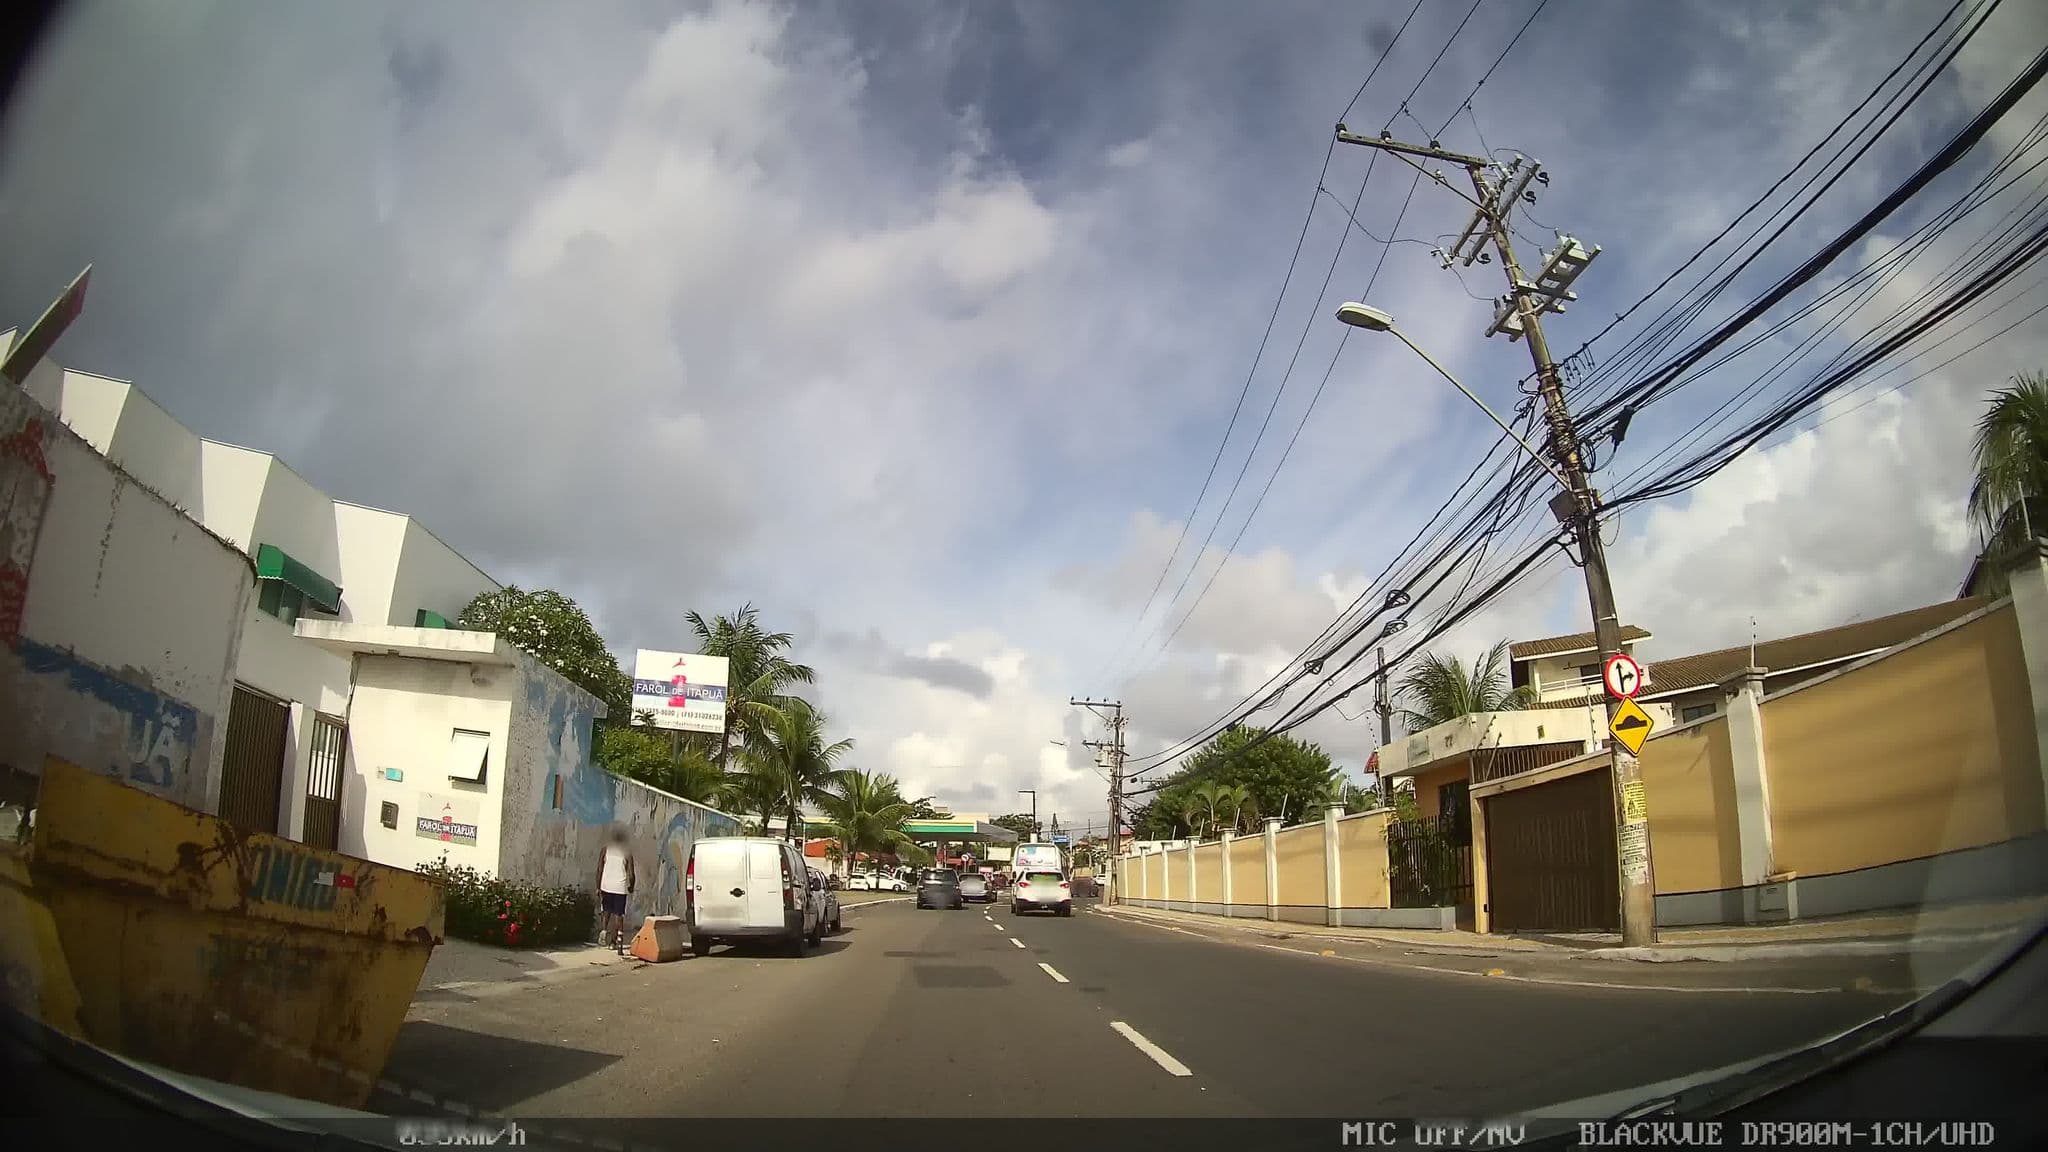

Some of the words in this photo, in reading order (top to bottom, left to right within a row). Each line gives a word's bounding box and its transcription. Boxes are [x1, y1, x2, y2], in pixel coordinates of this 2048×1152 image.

[636, 683, 668, 695] FAROL
[672, 687, 684, 696] DE
[419, 820, 441, 832] FAROL
